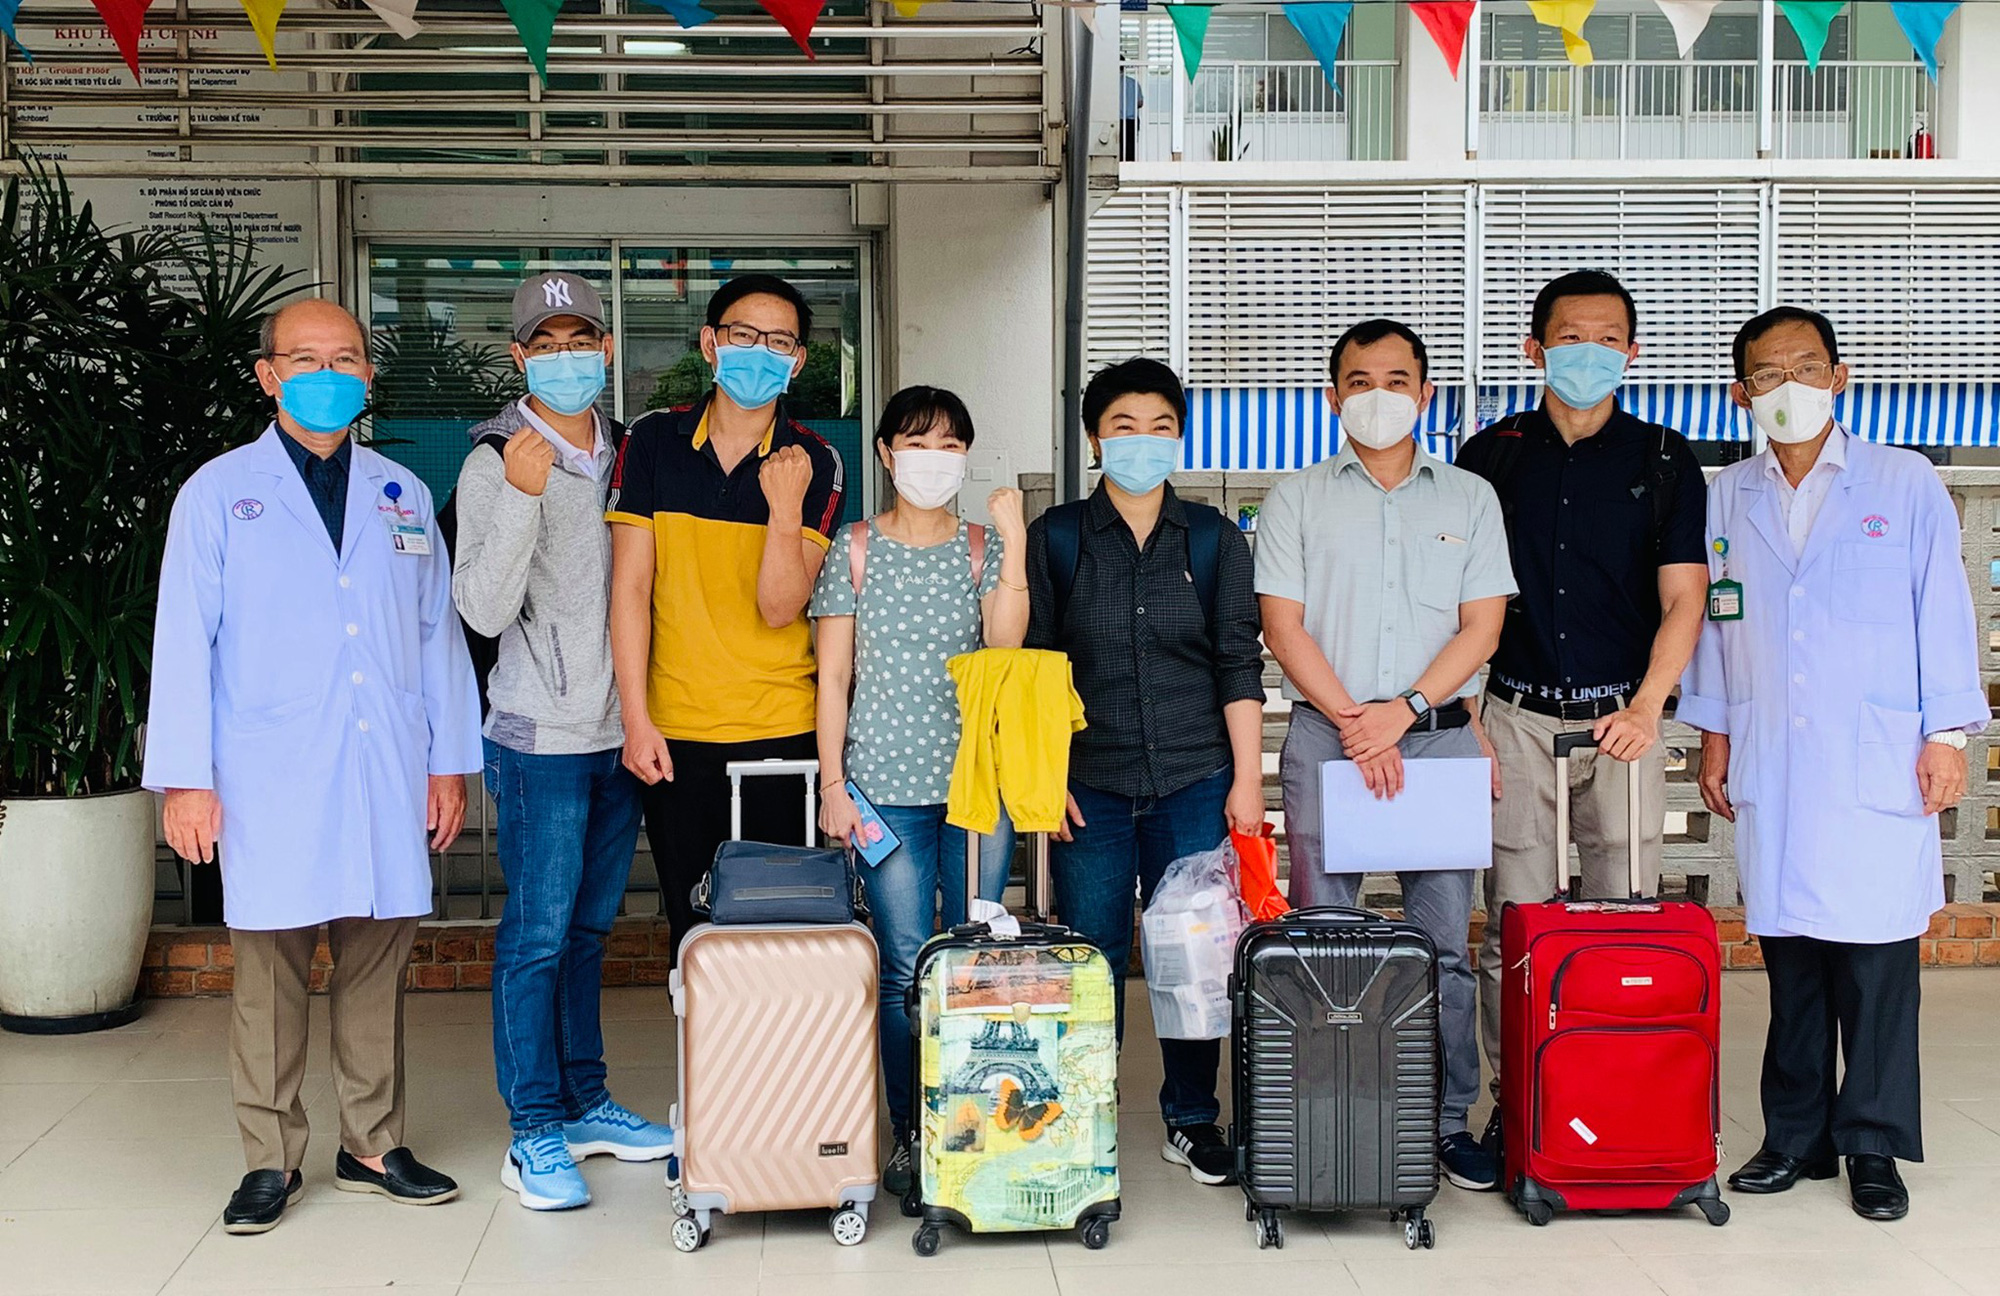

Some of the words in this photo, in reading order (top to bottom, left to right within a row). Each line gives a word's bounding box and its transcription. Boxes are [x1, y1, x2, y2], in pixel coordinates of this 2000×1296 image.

[55, 29, 93, 39] KHU
[100, 29, 152, 39] HH
[201, 78, 237, 86] Department
[17, 114, 49, 122] witchboard
[149, 211, 163, 219] Staff
[164, 211, 186, 219] Record
[243, 211, 278, 220] Department
[895, 574, 946, 586] MANGO
[1571, 680, 1631, 700] UNDER
